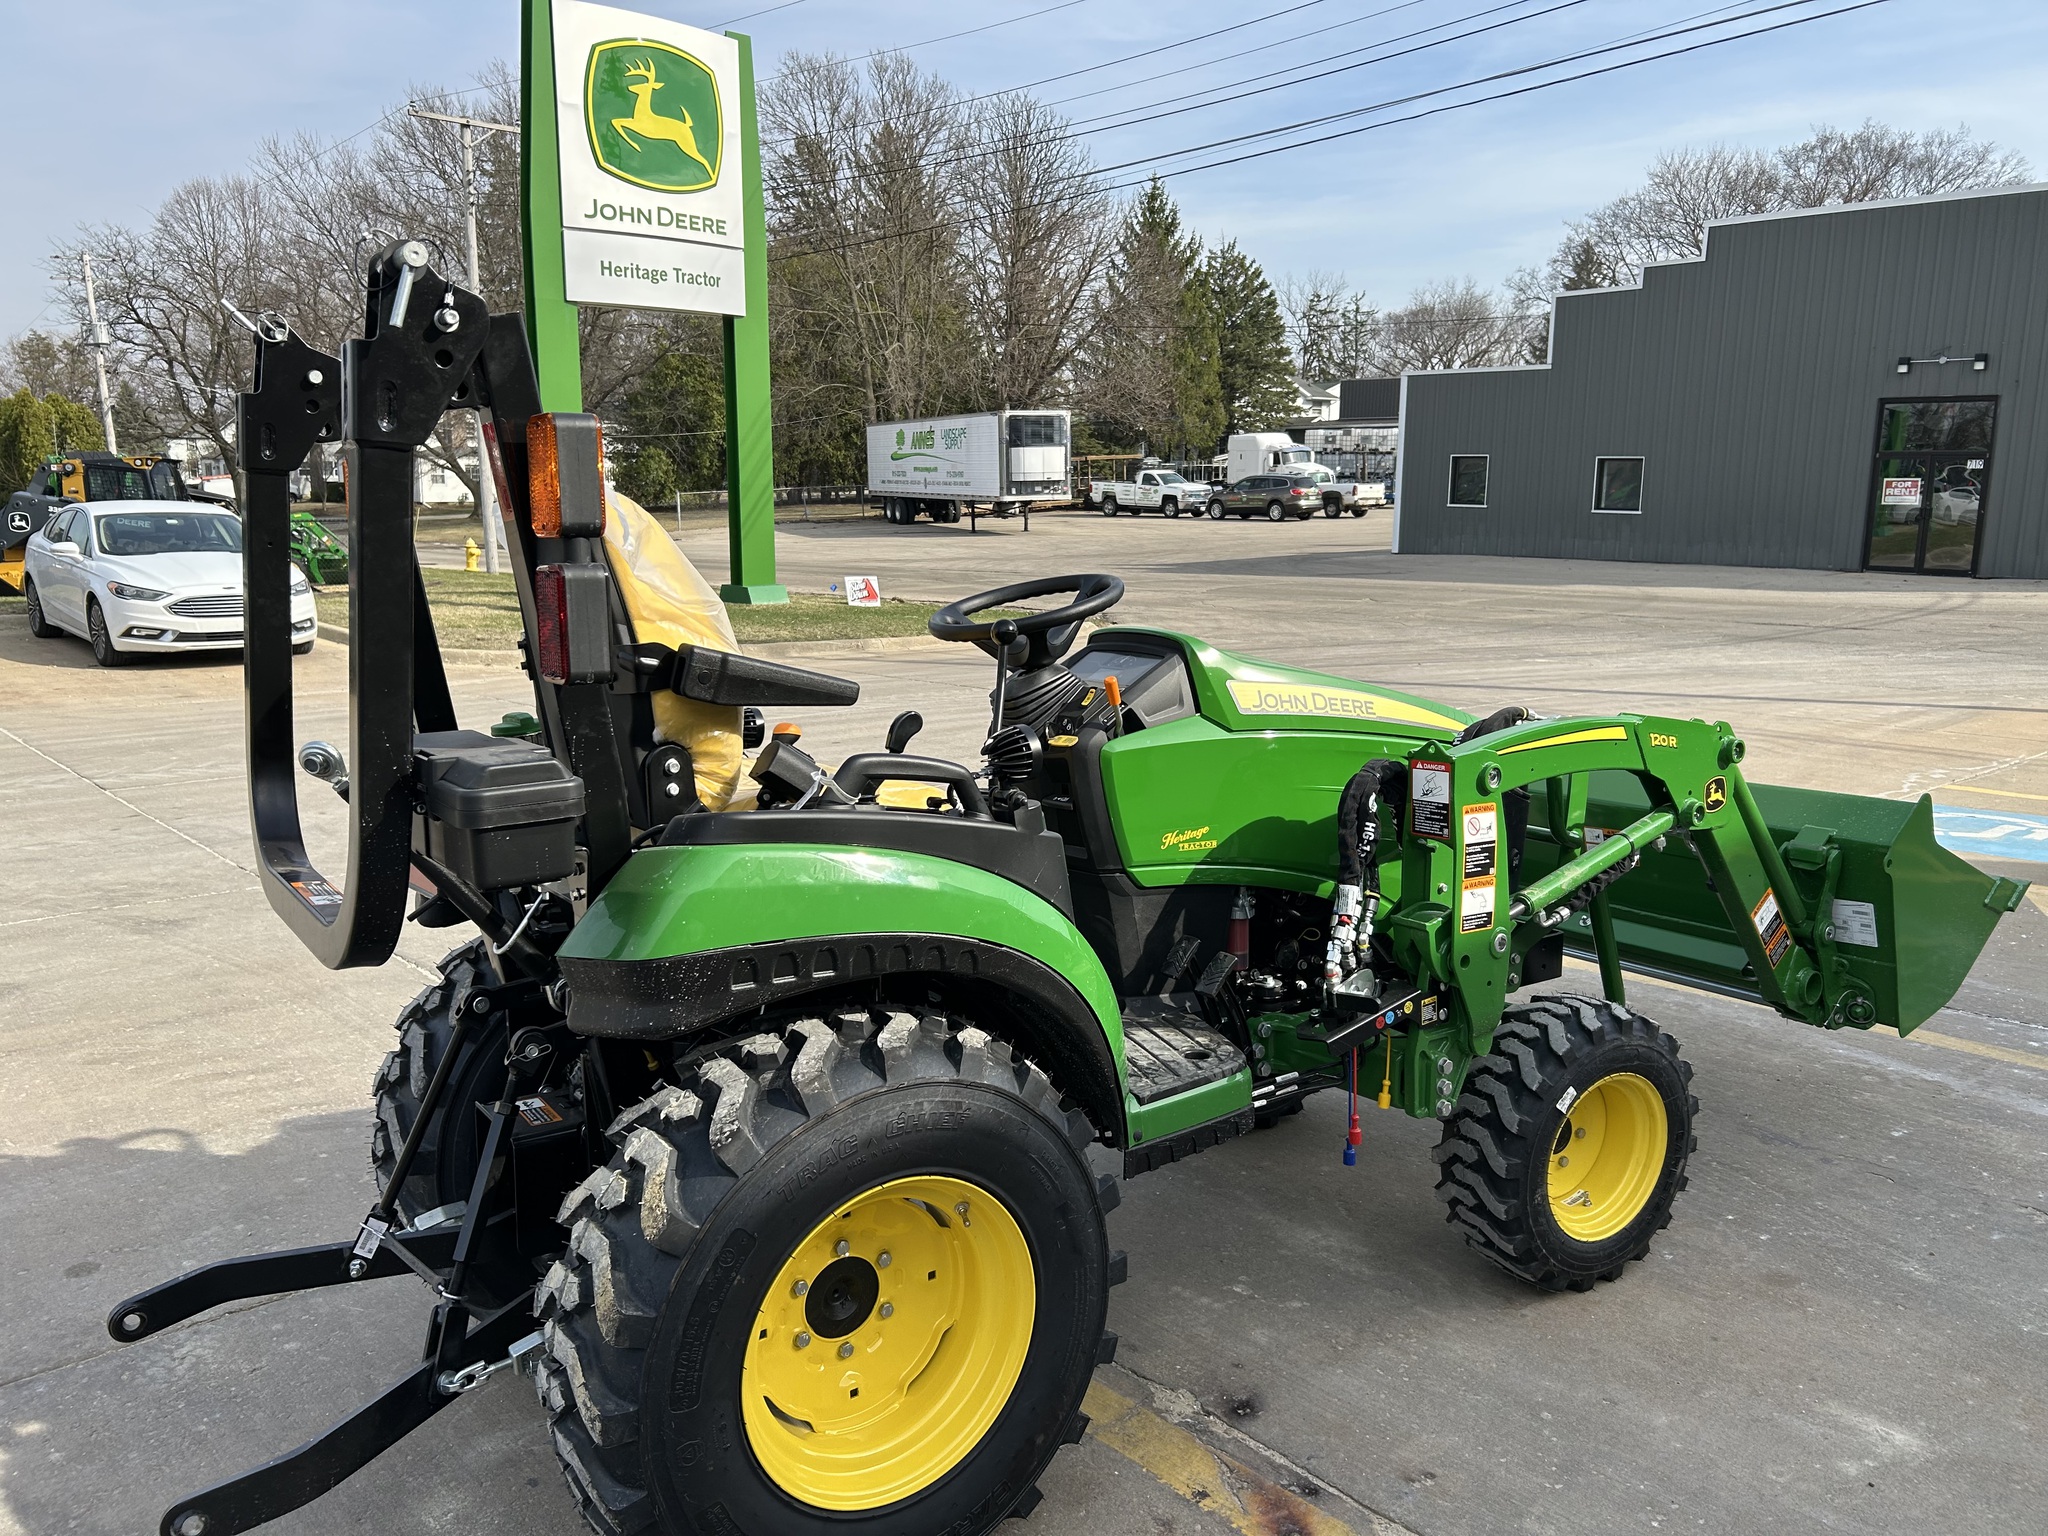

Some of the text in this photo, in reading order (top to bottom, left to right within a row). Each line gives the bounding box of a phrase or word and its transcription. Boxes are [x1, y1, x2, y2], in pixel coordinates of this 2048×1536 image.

[584, 199, 727, 236] JOHN DEERE
[600, 260, 721, 288] Heritage Tractor
[940, 427, 967, 440] LANDSCAPE
[944, 439, 963, 450] SUPPLY
[1885, 488, 1917, 496] RENT
[116, 517, 152, 528] DEERE
[1252, 690, 1377, 716] JOHN DEERE
[1423, 763, 1446, 771] DANGER
[1470, 804, 1495, 813] WARNING
[1160, 826, 1210, 850] Heritage
[1469, 879, 1494, 888] WARNING
[776, 1109, 971, 1201] TRAC CHIEF
